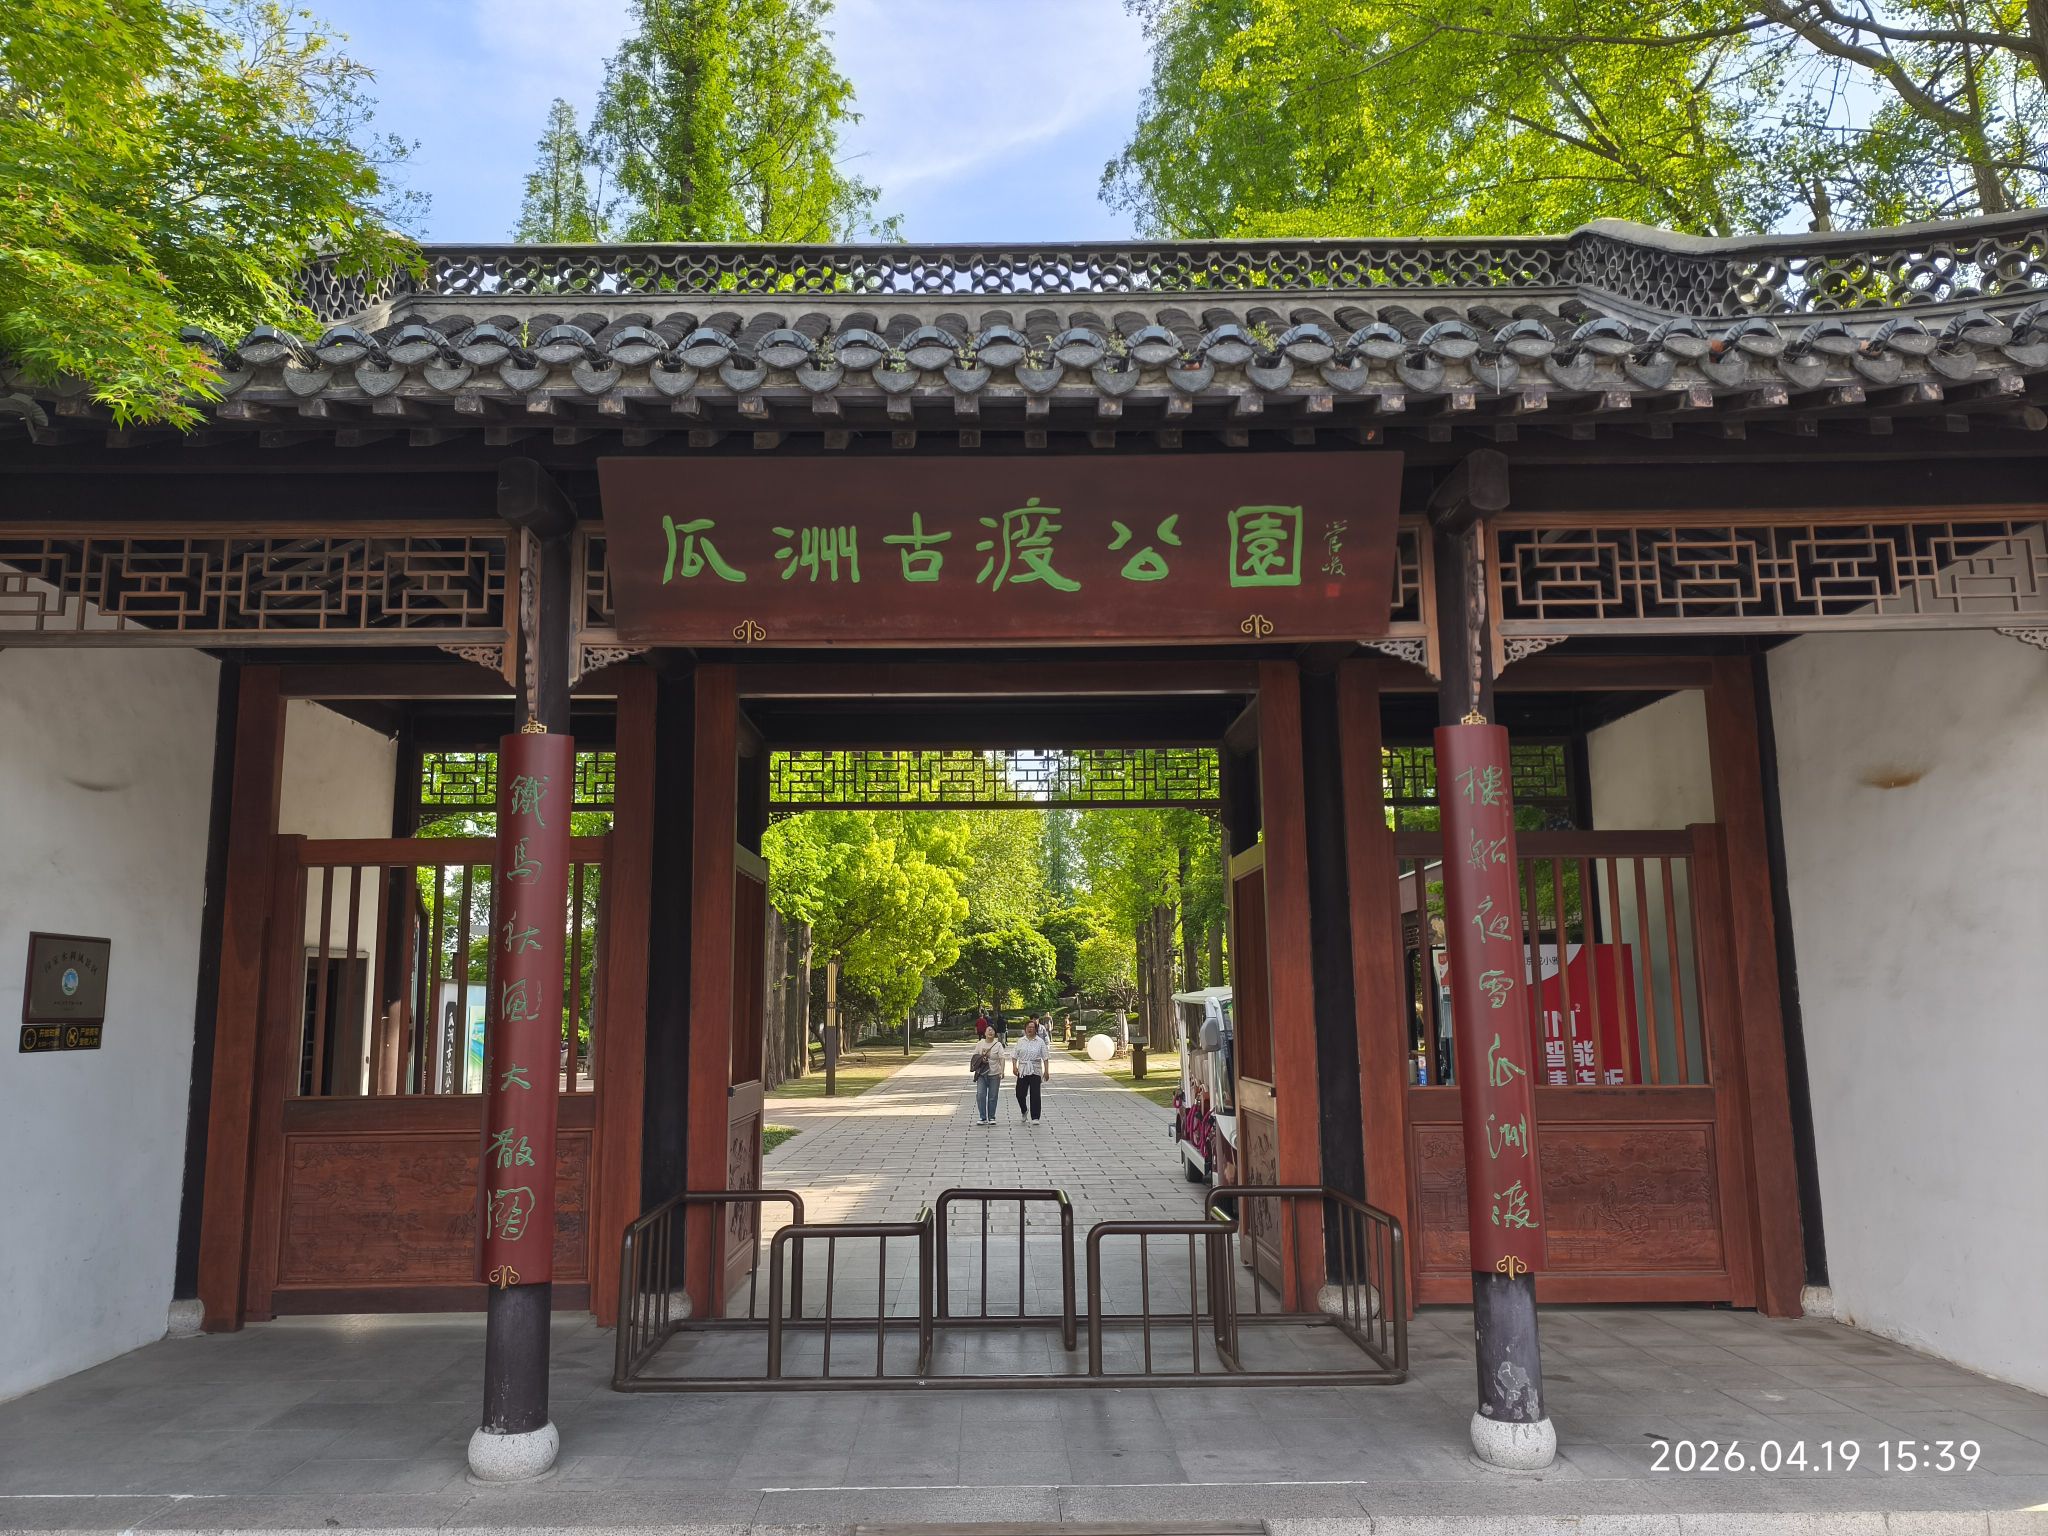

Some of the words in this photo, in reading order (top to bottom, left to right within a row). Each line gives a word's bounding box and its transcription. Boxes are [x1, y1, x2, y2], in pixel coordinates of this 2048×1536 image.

[662, 497, 1303, 593] 瓜洲古渡公園
[1545, 1040, 1595, 1067] 智能
